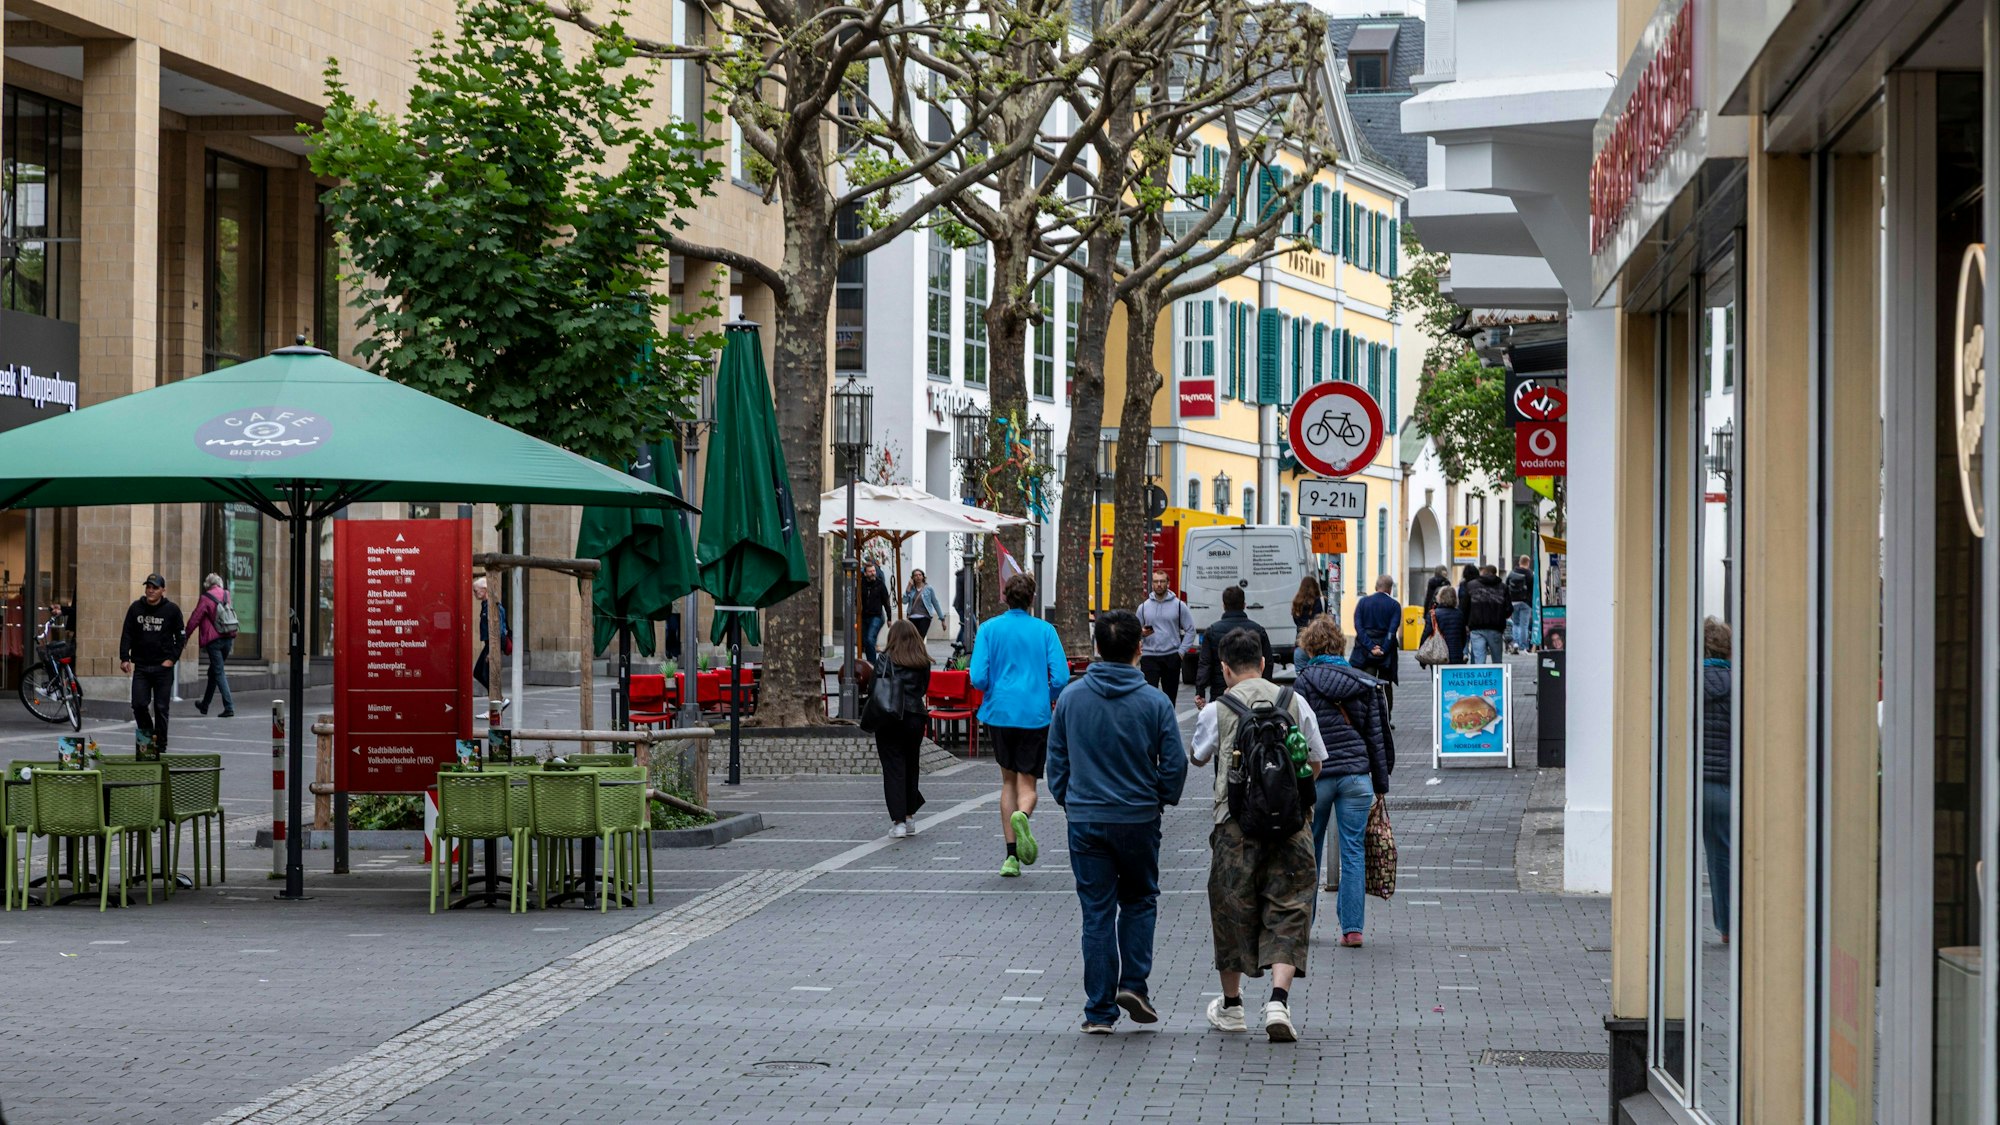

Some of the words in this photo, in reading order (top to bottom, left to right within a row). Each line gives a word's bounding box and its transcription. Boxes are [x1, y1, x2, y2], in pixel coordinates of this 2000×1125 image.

[1288, 251, 1325, 279] POSTAMT
[20, 365, 77, 412] Cloppenburg
[1520, 458, 1566, 468] vodafone
[1310, 490, 1357, 508] 9-21h
[367, 546, 420, 555] Rhein-Promenade
[367, 568, 415, 576] Beethoven-Haus
[367, 590, 382, 598] Altes
[383, 590, 407, 598] Rathaus
[384, 618, 419, 626] Information
[367, 640, 427, 648] Beethoven-Denkmal
[367, 662, 406, 671] Münsterplatz
[1452, 671, 1475, 679] HEISS
[367, 704, 392, 712] Münster
[367, 746, 414, 754] Stadtbibliothek
[367, 756, 416, 764] Volkshochschule
[416, 756, 434, 765] (VHS)
